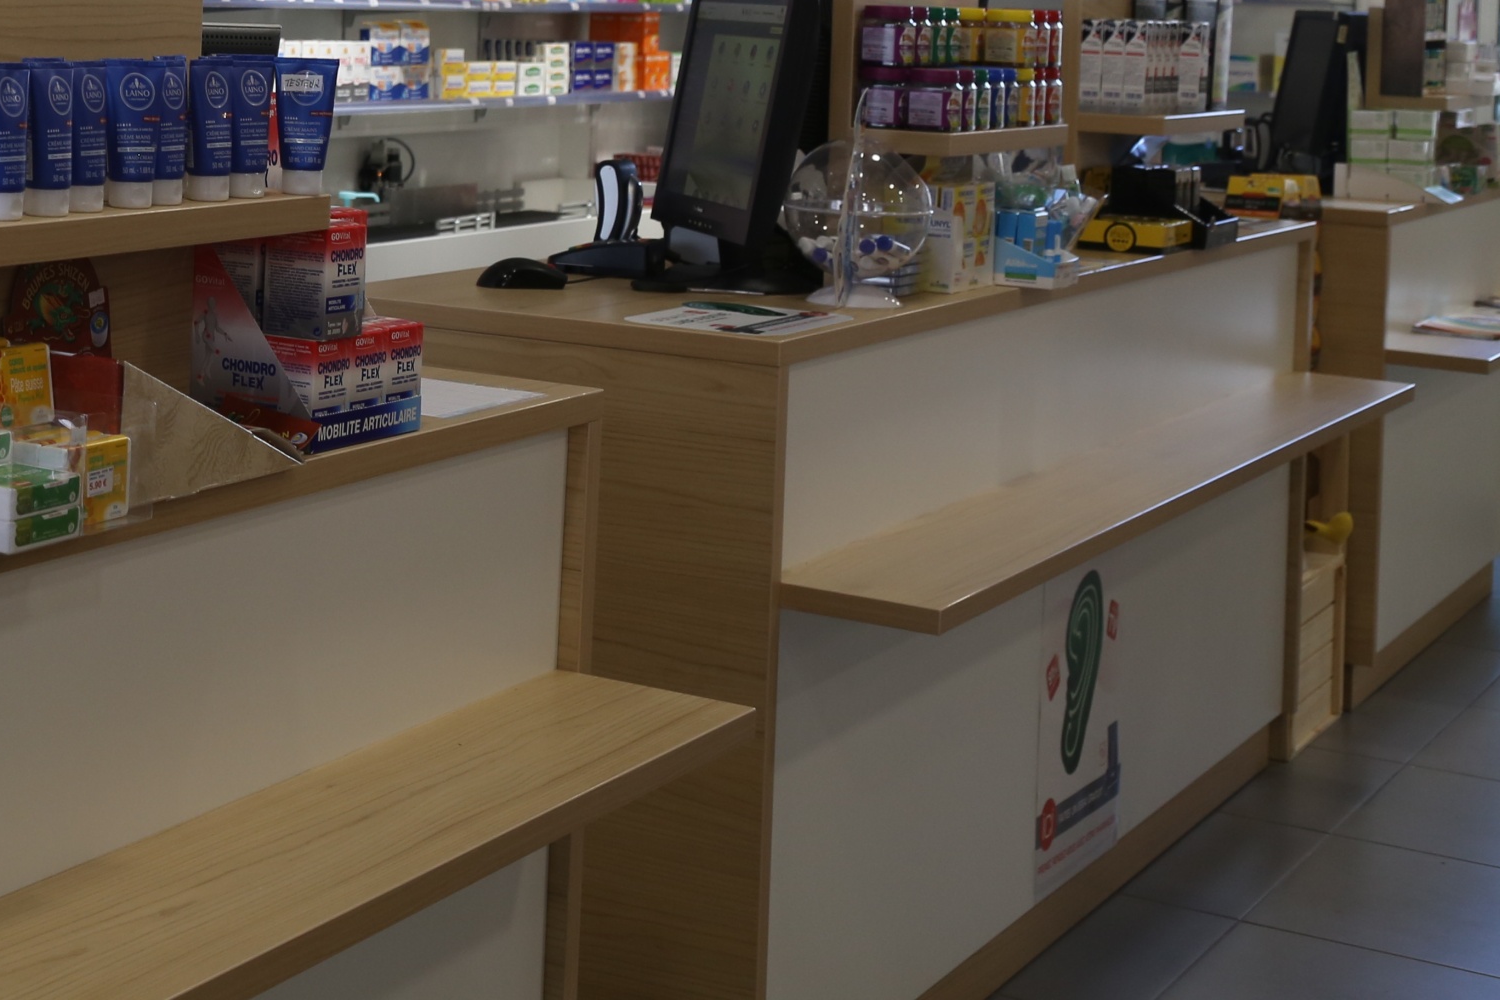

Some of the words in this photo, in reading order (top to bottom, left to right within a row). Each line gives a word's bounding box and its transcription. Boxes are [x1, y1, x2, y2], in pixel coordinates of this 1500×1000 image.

[2, 94, 21, 102] LAINO
[331, 232, 350, 241] GOVital
[331, 247, 364, 263] CHONDRO
[337, 261, 357, 277] FLEX
[21, 264, 56, 310] BAUMES
[57, 261, 91, 292] SHIZEN
[355, 337, 375, 347] GOVital
[391, 329, 410, 340] GOVital
[319, 343, 338, 353] GOVital
[391, 344, 421, 360] CHONDRO
[222, 357, 276, 377] CHONDRO
[318, 358, 350, 375] CHONDRO
[355, 351, 386, 368] CHONDRO
[397, 359, 415, 374] FLEX
[232, 372, 264, 391] FLEX
[324, 373, 344, 389] FLEX
[361, 366, 381, 382] FLEX
[10, 377, 25, 393] Pâte
[317, 418, 360, 442] MOBILITE
[362, 406, 417, 432] ARTICULAIRE
